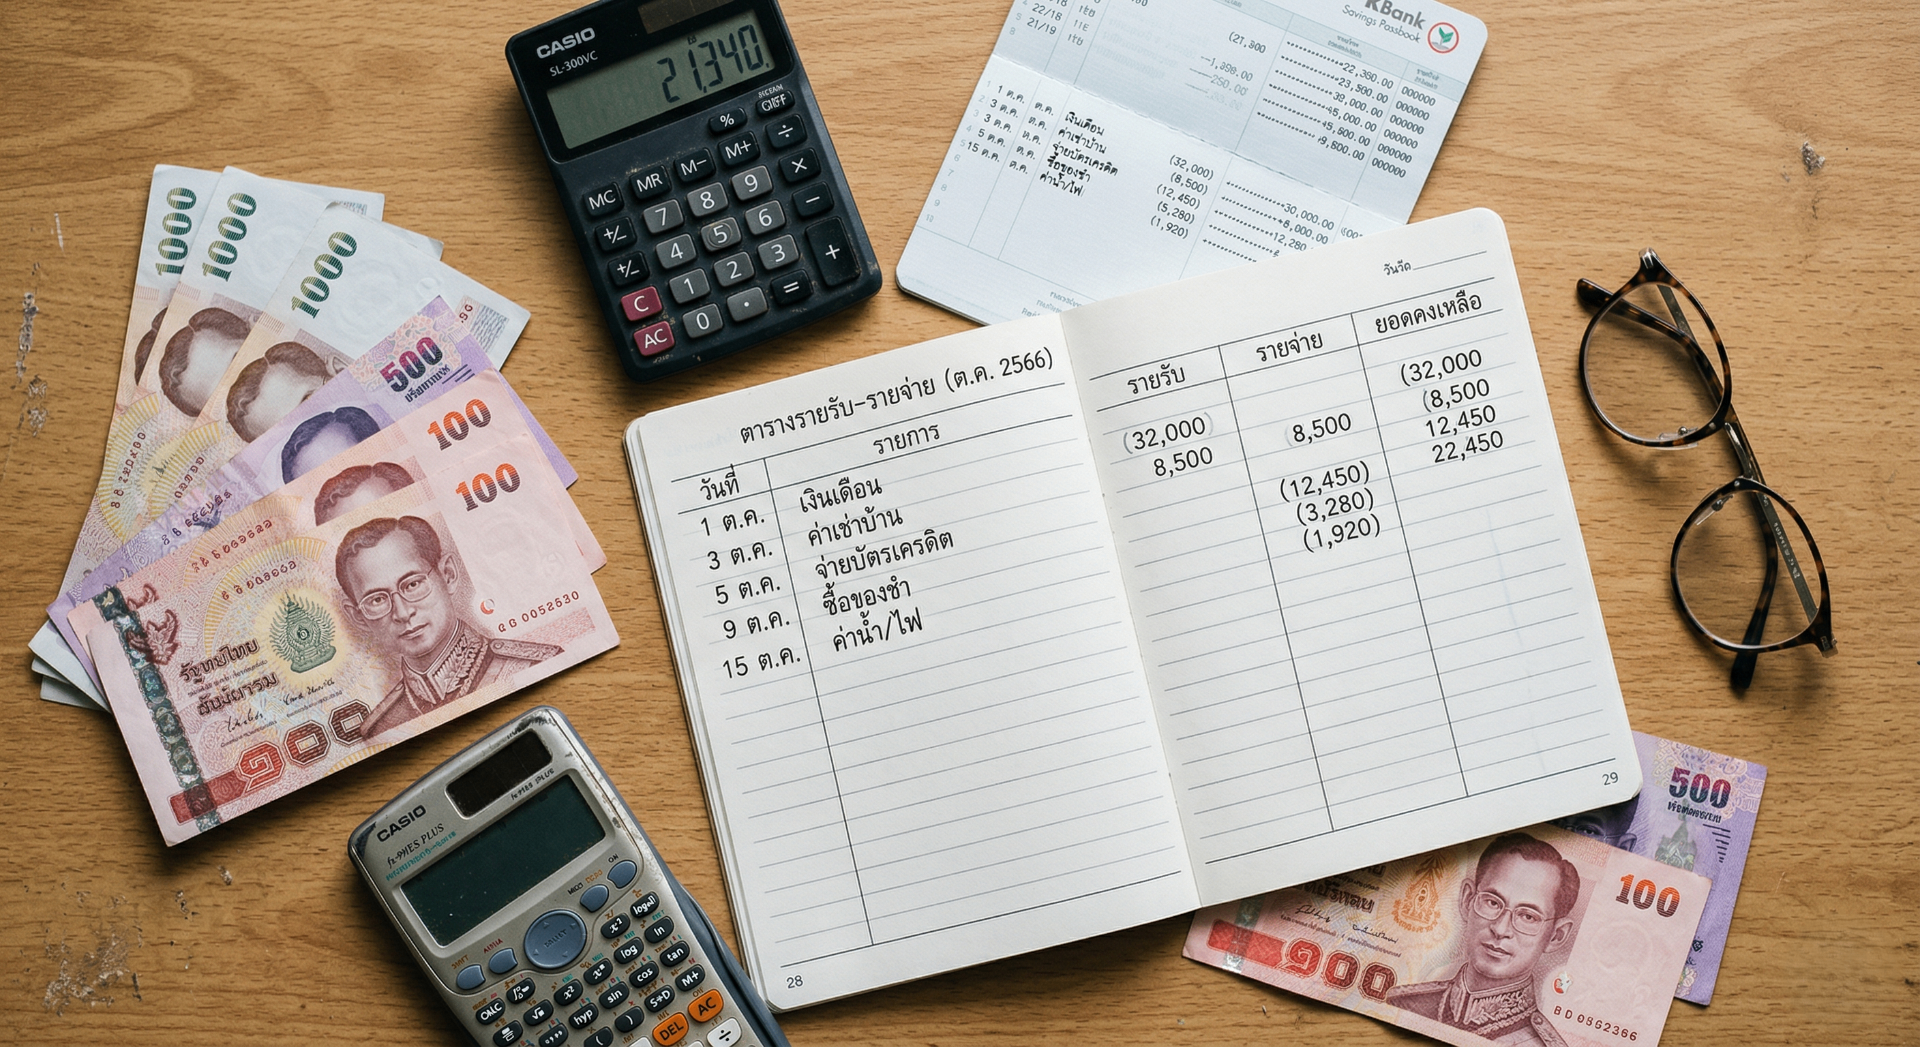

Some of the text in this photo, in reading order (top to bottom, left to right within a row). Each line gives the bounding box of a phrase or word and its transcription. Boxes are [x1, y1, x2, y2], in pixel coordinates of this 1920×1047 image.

[1027, 17, 1057, 35] 21/19
[1342, 4, 1421, 43] Savings Passbook
[1365, 0, 1426, 30] KBank
[536, 27, 596, 59] CASIO
[550, 50, 598, 77] SL-300VC
[997, 85, 1003, 94] 1
[990, 99, 998, 108] 3
[720, 113, 735, 127] %
[983, 113, 991, 123] 3
[977, 128, 985, 138] 5
[725, 140, 751, 159] M+
[967, 141, 979, 153] 15
[1169, 154, 1215, 181] (32,000)
[637, 173, 663, 193] MR
[744, 174, 758, 192] 9
[1170, 171, 1209, 195] (8,500)
[588, 189, 616, 210] MC
[701, 191, 715, 209] 8
[1156, 183, 1201, 210] (12,450)
[655, 208, 667, 226] 7
[759, 208, 772, 227] 6
[1156, 201, 1195, 224] (5,280)
[155, 187, 198, 276] 1000
[201, 192, 258, 282] 1000
[713, 225, 727, 243] 5
[1150, 215, 1189, 240] (1,920)
[670, 242, 683, 260] 4
[774, 244, 786, 262] 3
[290, 230, 358, 320] 1000
[727, 261, 741, 279] 2
[684, 278, 695, 295] 1
[634, 296, 649, 312] C
[1375, 290, 1482, 334] ยอดคงเหลือ
[696, 312, 710, 330] 0
[644, 329, 668, 348] AC
[1256, 332, 1323, 362] รายจ่าย
[379, 337, 443, 393] 500
[945, 367, 994, 393] (ต.ค.
[999, 346, 1053, 377] 2566)
[1401, 349, 1482, 386] (32,000
[1127, 362, 1186, 395] รายรับ
[1423, 378, 1489, 413] (8,500
[427, 398, 491, 451] 100
[1426, 405, 1496, 437] 12,450
[872, 422, 941, 455] รายการ
[1432, 430, 1503, 463] 22,450
[1153, 446, 1213, 477] 8,500
[455, 463, 521, 512] 100
[700, 464, 740, 500] วันที่
[1280, 460, 1370, 503] (12,450)
[700, 476, 883, 536] 1 ต.ค. เงินเดือน
[1296, 487, 1374, 527] (3,280)
[707, 505, 903, 570] 3 ต.ค. ค่าเช่าบ้าน
[1303, 513, 1381, 553] (1,920)
[715, 528, 954, 605] 5 ต.ค. จ่ายบัตรเครดิต
[723, 575, 911, 639] 9 ต.ค. ซื้อของชำ
[722, 607, 923, 679] 15 ต.ค. ค่าน้ำ/ไฟ
[1602, 772, 1619, 786] 29
[1669, 766, 1731, 809] 500
[377, 805, 426, 842] CASIO
[420, 823, 445, 844] PLUS
[1616, 874, 1680, 918] 100
[620, 944, 638, 959] log
[667, 948, 684, 961] tan
[637, 969, 653, 982] cos
[681, 971, 700, 986] M+
[786, 975, 803, 989] 28
[574, 1010, 594, 1026] hyp
[698, 997, 716, 1016] AC
[659, 1022, 684, 1041] DEL
